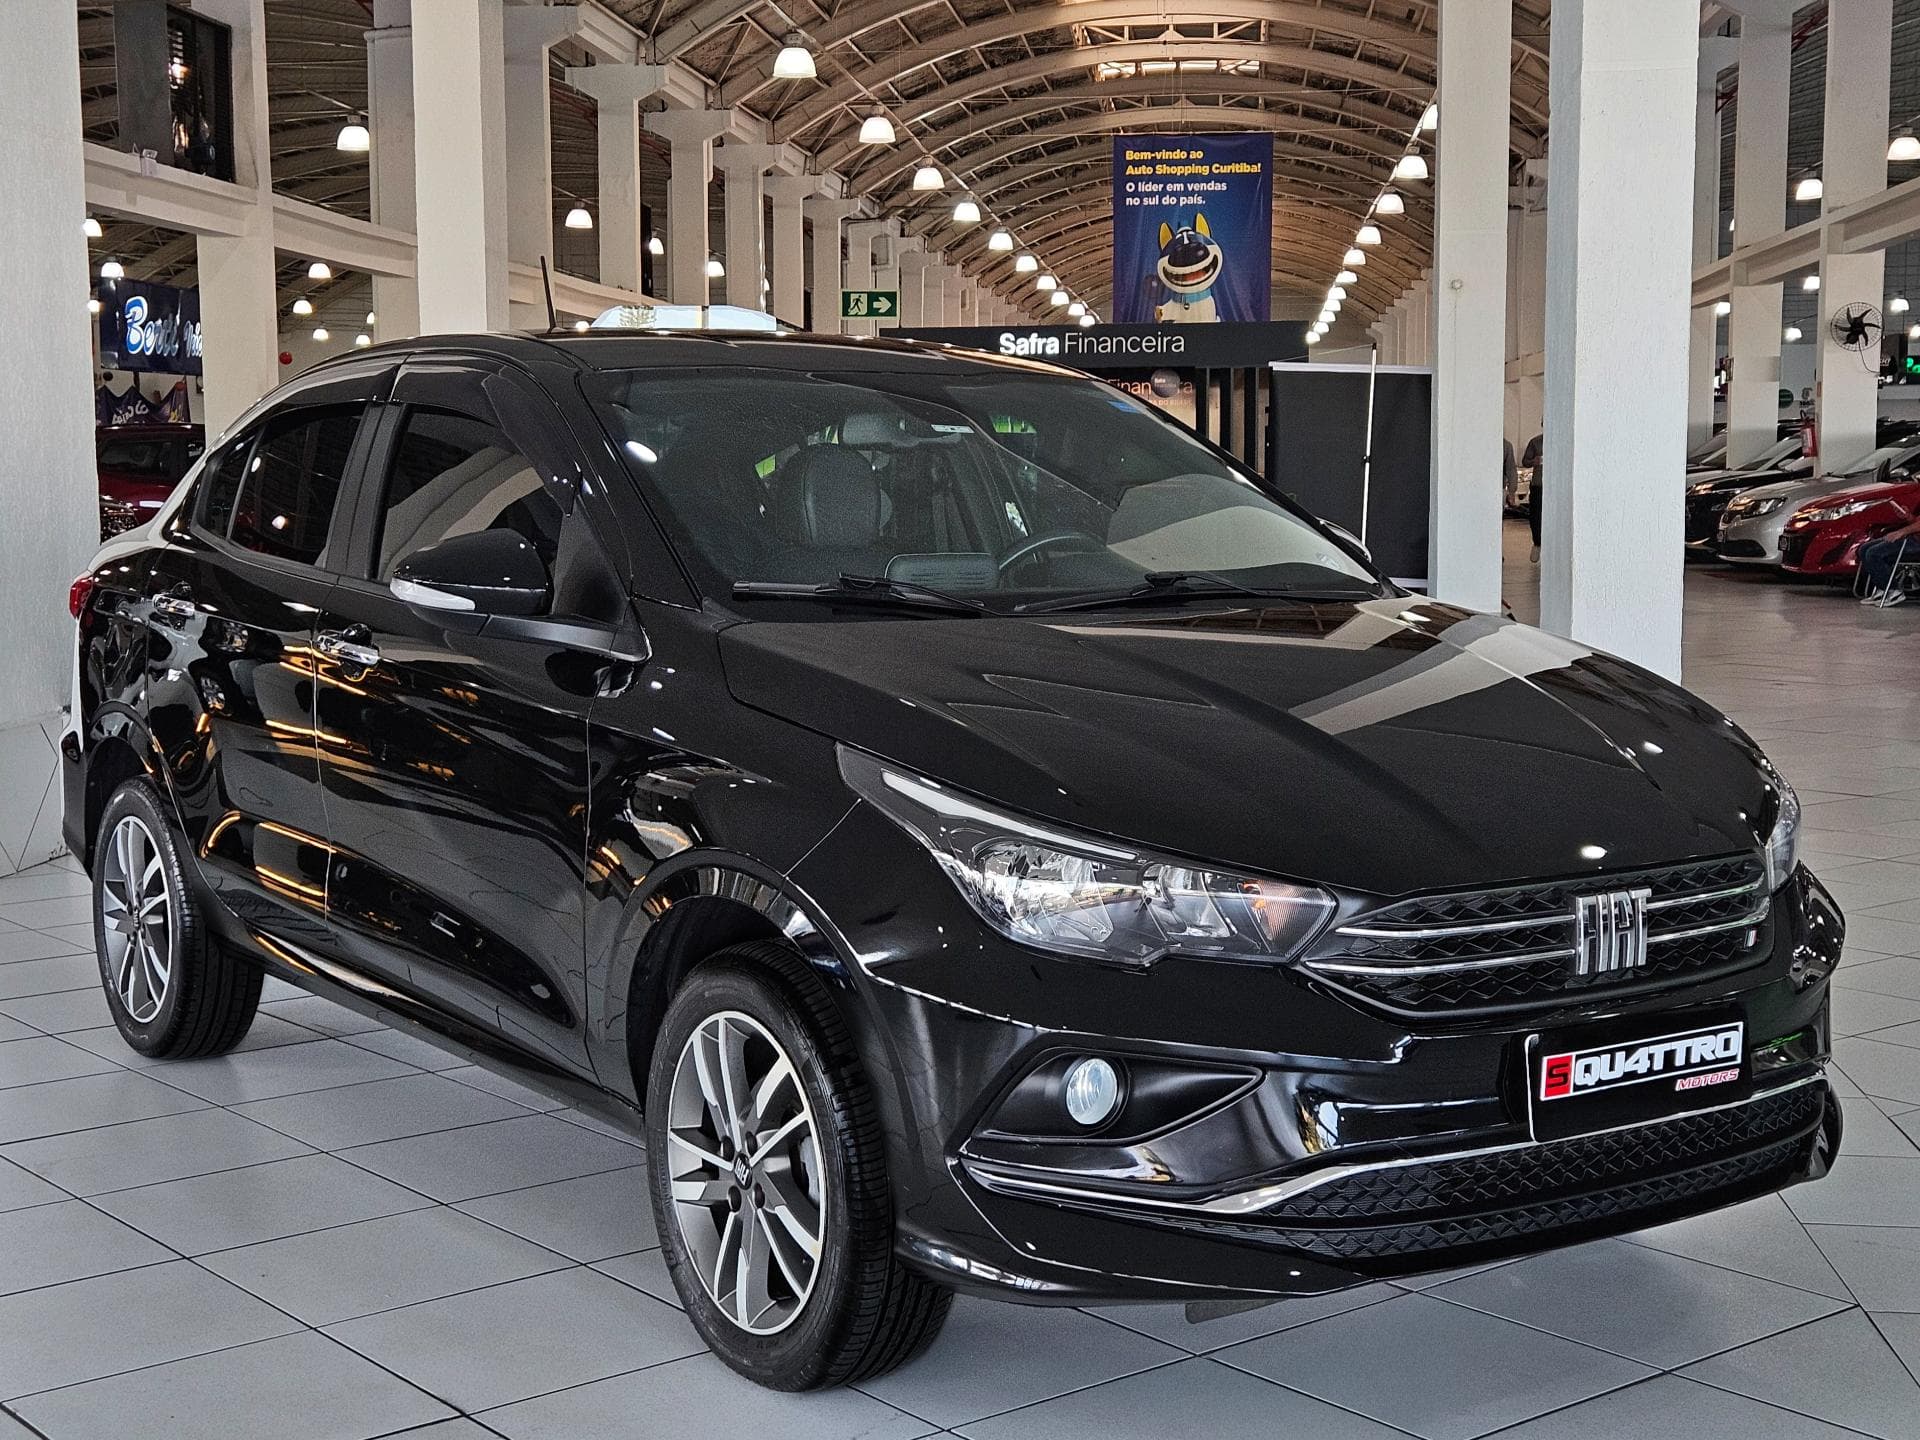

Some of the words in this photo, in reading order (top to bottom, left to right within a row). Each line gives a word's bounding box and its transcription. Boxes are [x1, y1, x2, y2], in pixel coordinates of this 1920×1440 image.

[1125, 149, 1188, 160] Bem-vindo
[1189, 151, 1204, 159] ao
[1125, 164, 1153, 175] Auto
[1155, 163, 1210, 176] Shopping
[1211, 163, 1262, 174] Curitiba!
[1125, 182, 1135, 192] O
[1138, 181, 1164, 192] líder
[1166, 183, 1184, 192] em
[1187, 181, 1227, 191] vendas
[1125, 196, 1140, 206] no
[1142, 195, 1159, 205] sul
[1161, 195, 1177, 205] do
[1179, 193, 1206, 206] país.
[999, 332, 1060, 355] Safra
[1064, 331, 1185, 354] Financeira
[1575, 888, 1652, 976] FIAT
[1674, 1068, 1740, 1092] MOTORS
